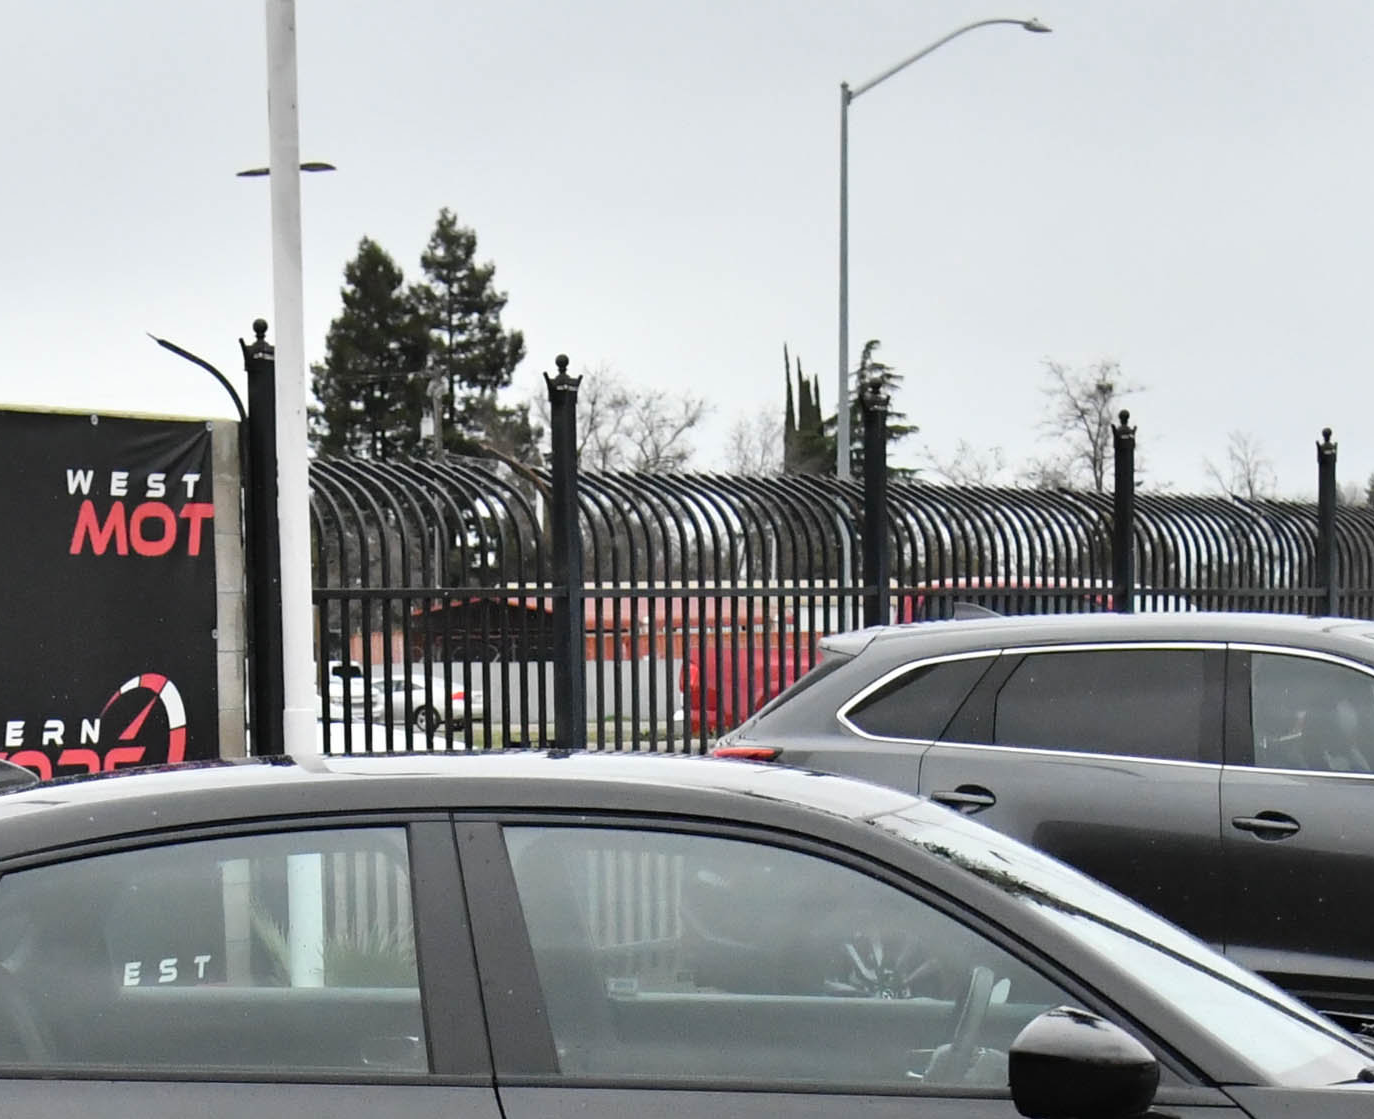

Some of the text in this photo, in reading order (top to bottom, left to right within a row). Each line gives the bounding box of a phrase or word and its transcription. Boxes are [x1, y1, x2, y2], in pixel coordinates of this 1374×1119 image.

[66, 469, 201, 499] WEST
[70, 499, 215, 557] MOT
[123, 955, 211, 986] EST
